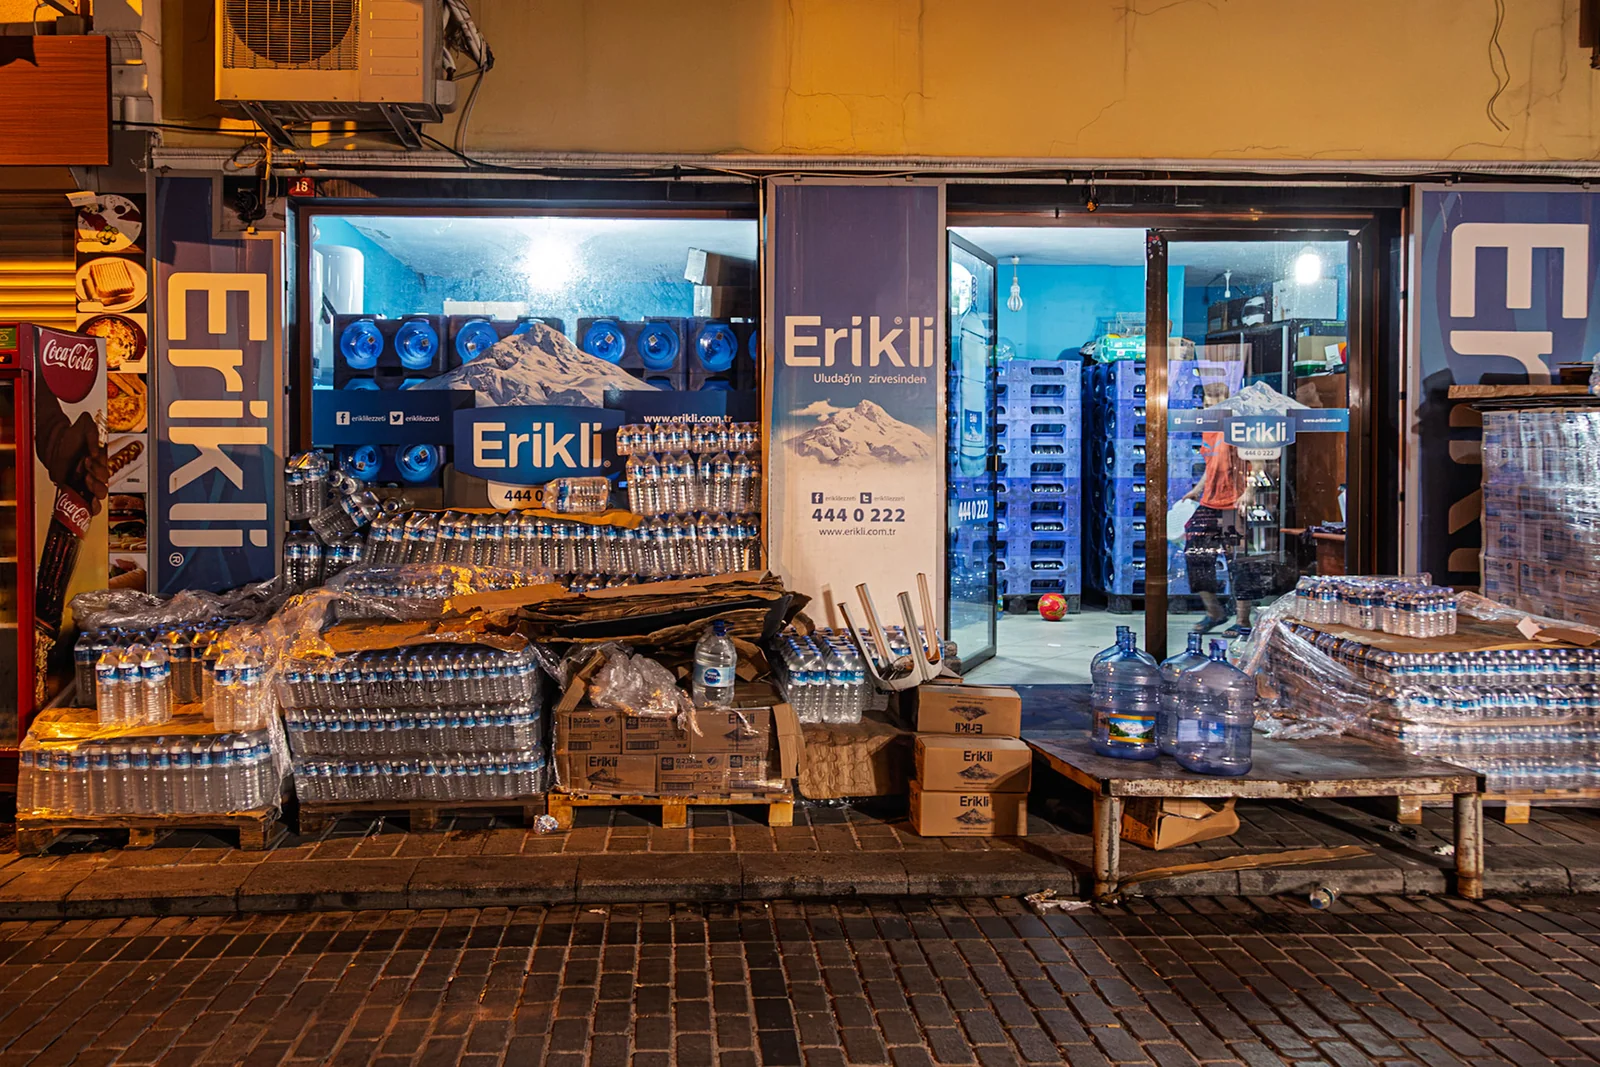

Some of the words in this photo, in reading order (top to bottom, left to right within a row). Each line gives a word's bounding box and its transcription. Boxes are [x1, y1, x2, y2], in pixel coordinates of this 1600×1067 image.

[295, 181, 308, 192] 18
[784, 315, 934, 368] Erikli
[868, 374, 927, 385] zirvesinden
[168, 272, 268, 547] Erikli
[643, 413, 733, 424] www.erikli.com.tr
[1230, 422, 1287, 443] Erikli
[473, 422, 602, 468] Erikli
[504, 489, 532, 502] 444
[535, 489, 544, 502] 0
[811, 508, 848, 522] 444
[853, 508, 865, 522] 0
[870, 508, 905, 522] 222
[958, 501, 971, 521] 444
[977, 500, 989, 519] 222
[819, 527, 896, 536] www.erikli.com.tr
[954, 722, 983, 734] Erikli
[589, 756, 618, 768] Erikli
[963, 750, 993, 762] Erikli
[959, 795, 989, 807] Erikli
